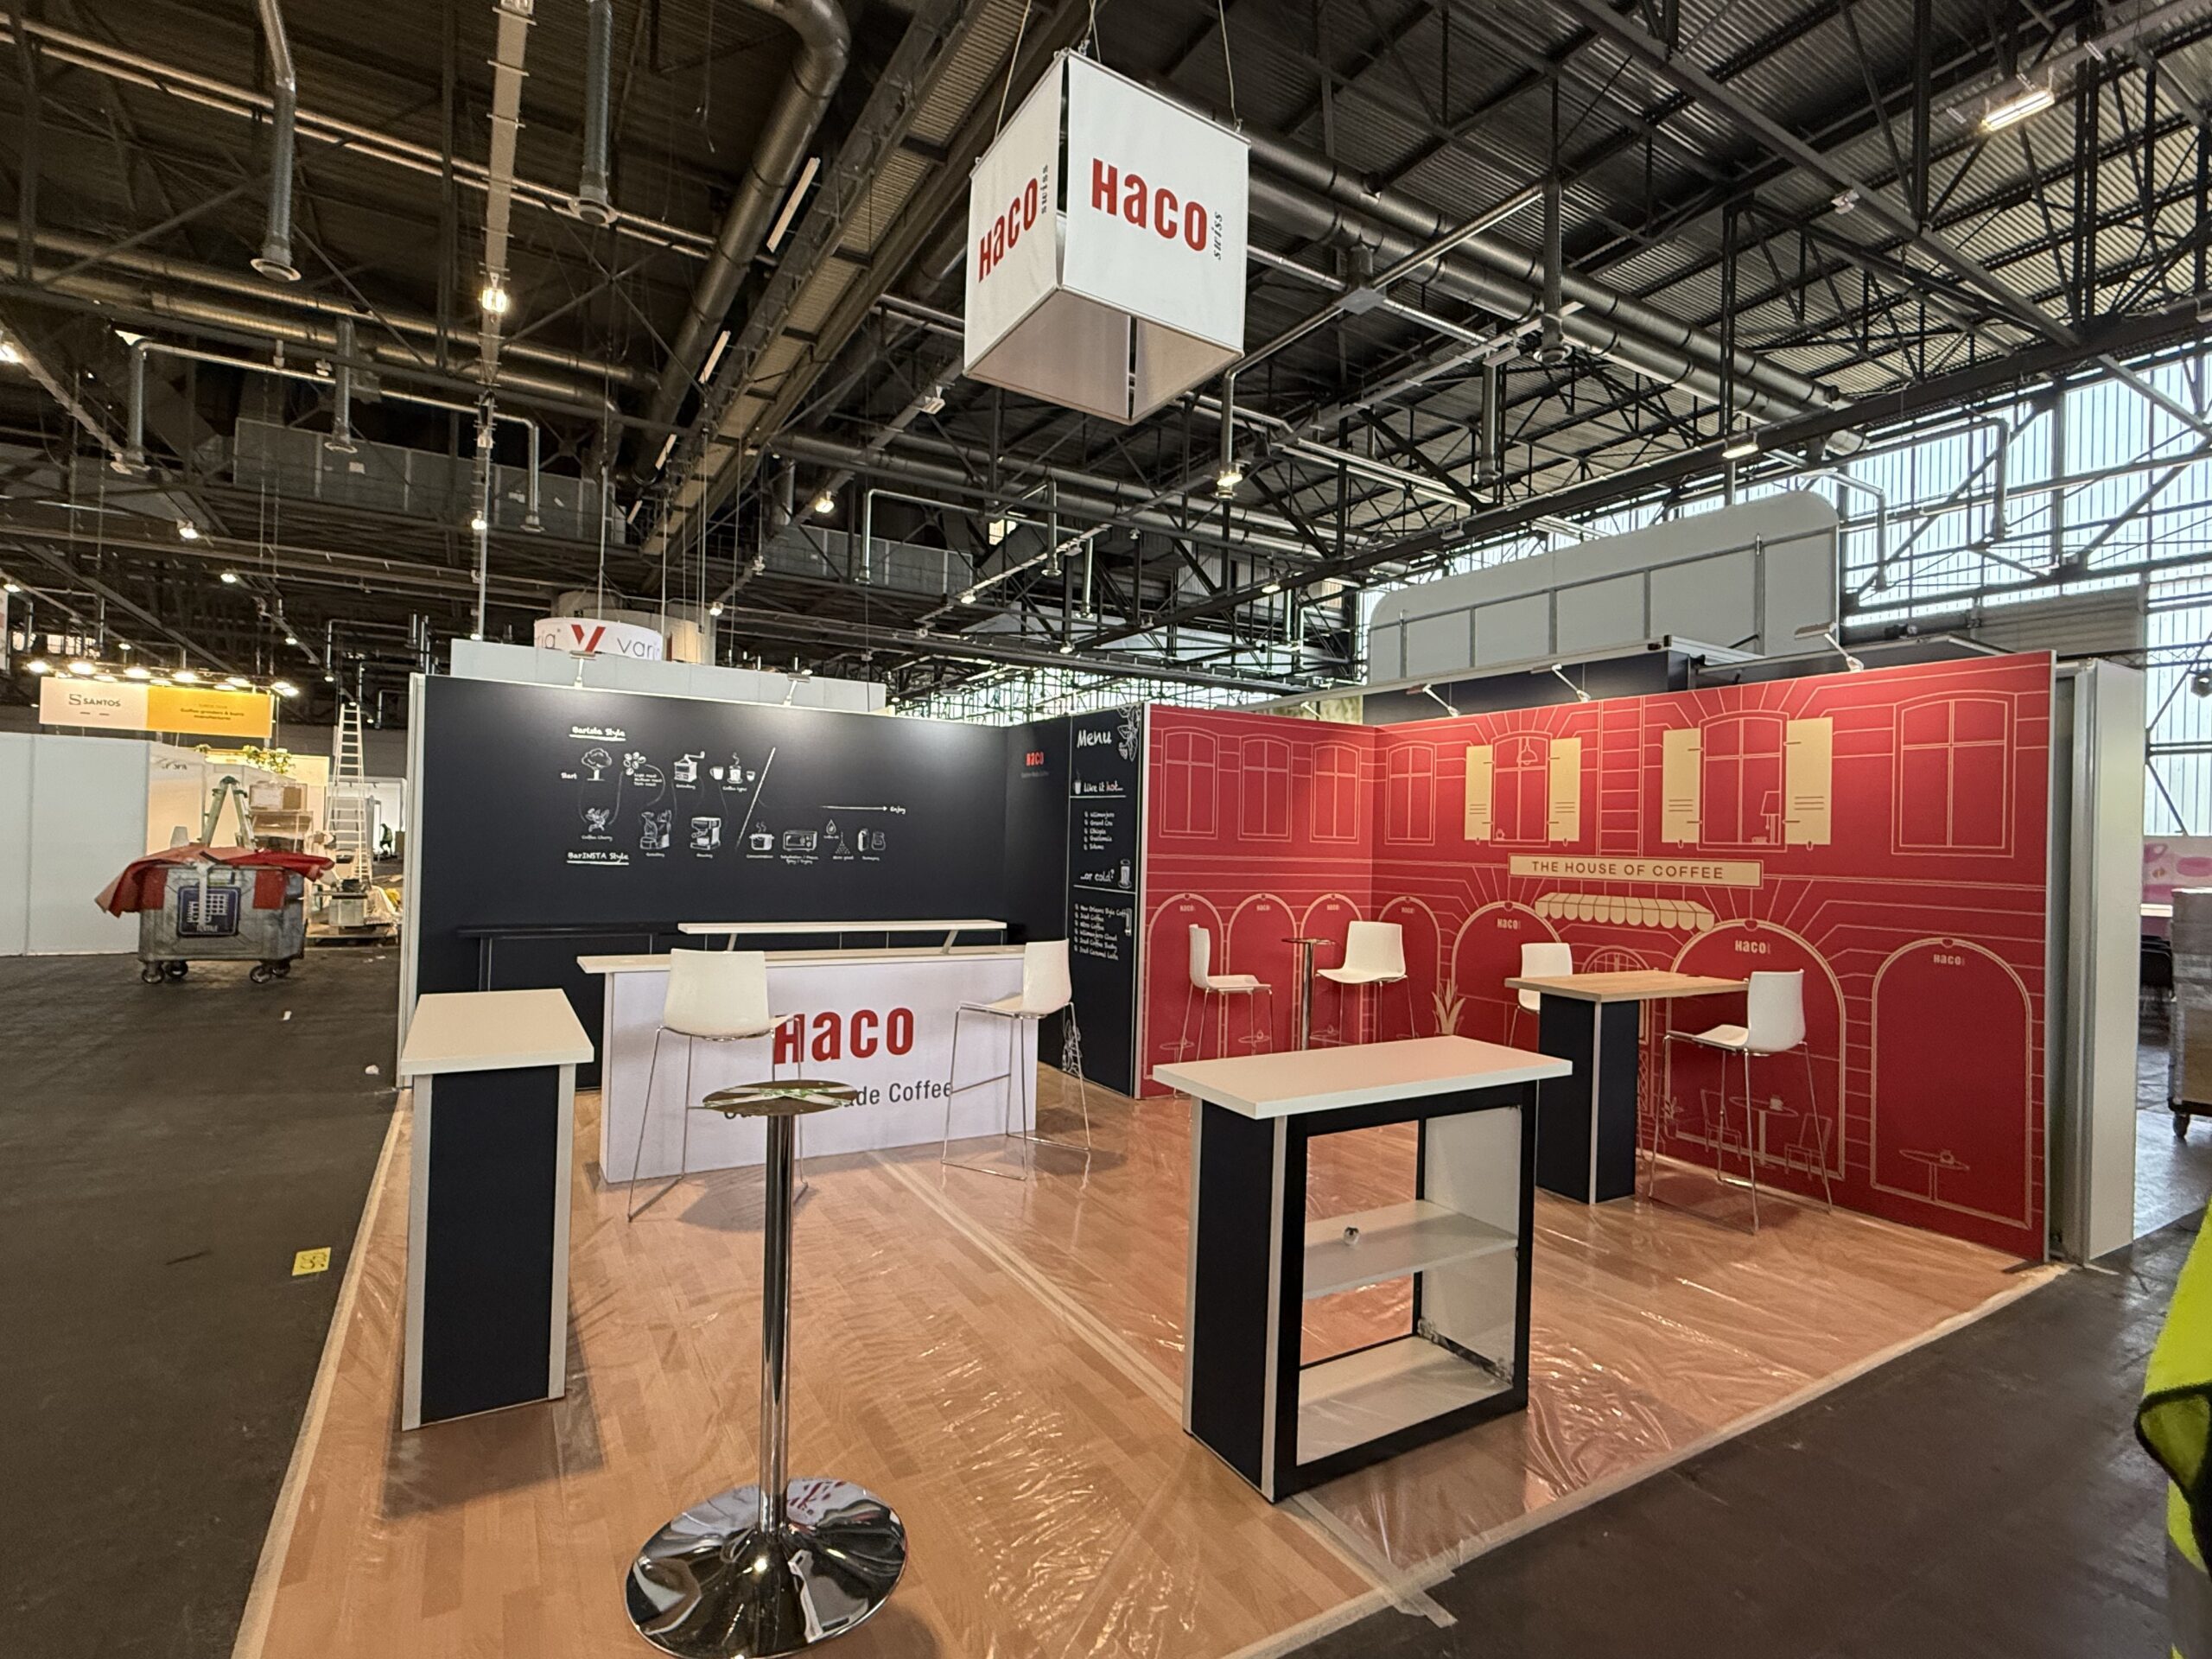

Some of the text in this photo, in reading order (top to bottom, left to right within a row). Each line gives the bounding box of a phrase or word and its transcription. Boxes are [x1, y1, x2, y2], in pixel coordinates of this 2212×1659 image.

[1213, 211, 1223, 260] swiss
[83, 697, 121, 707] SANTOS
[572, 726, 626, 738] Barista Style
[1077, 729, 1112, 749] Menu
[1098, 781, 1105, 792] it
[890, 805, 906, 815] Enjoy
[609, 852, 629, 862] Style
[1094, 868, 1115, 881] cold?
[1532, 861, 1724, 880] THE HOUSE OF COFFEE
[888, 1079, 952, 1103] Coffee
